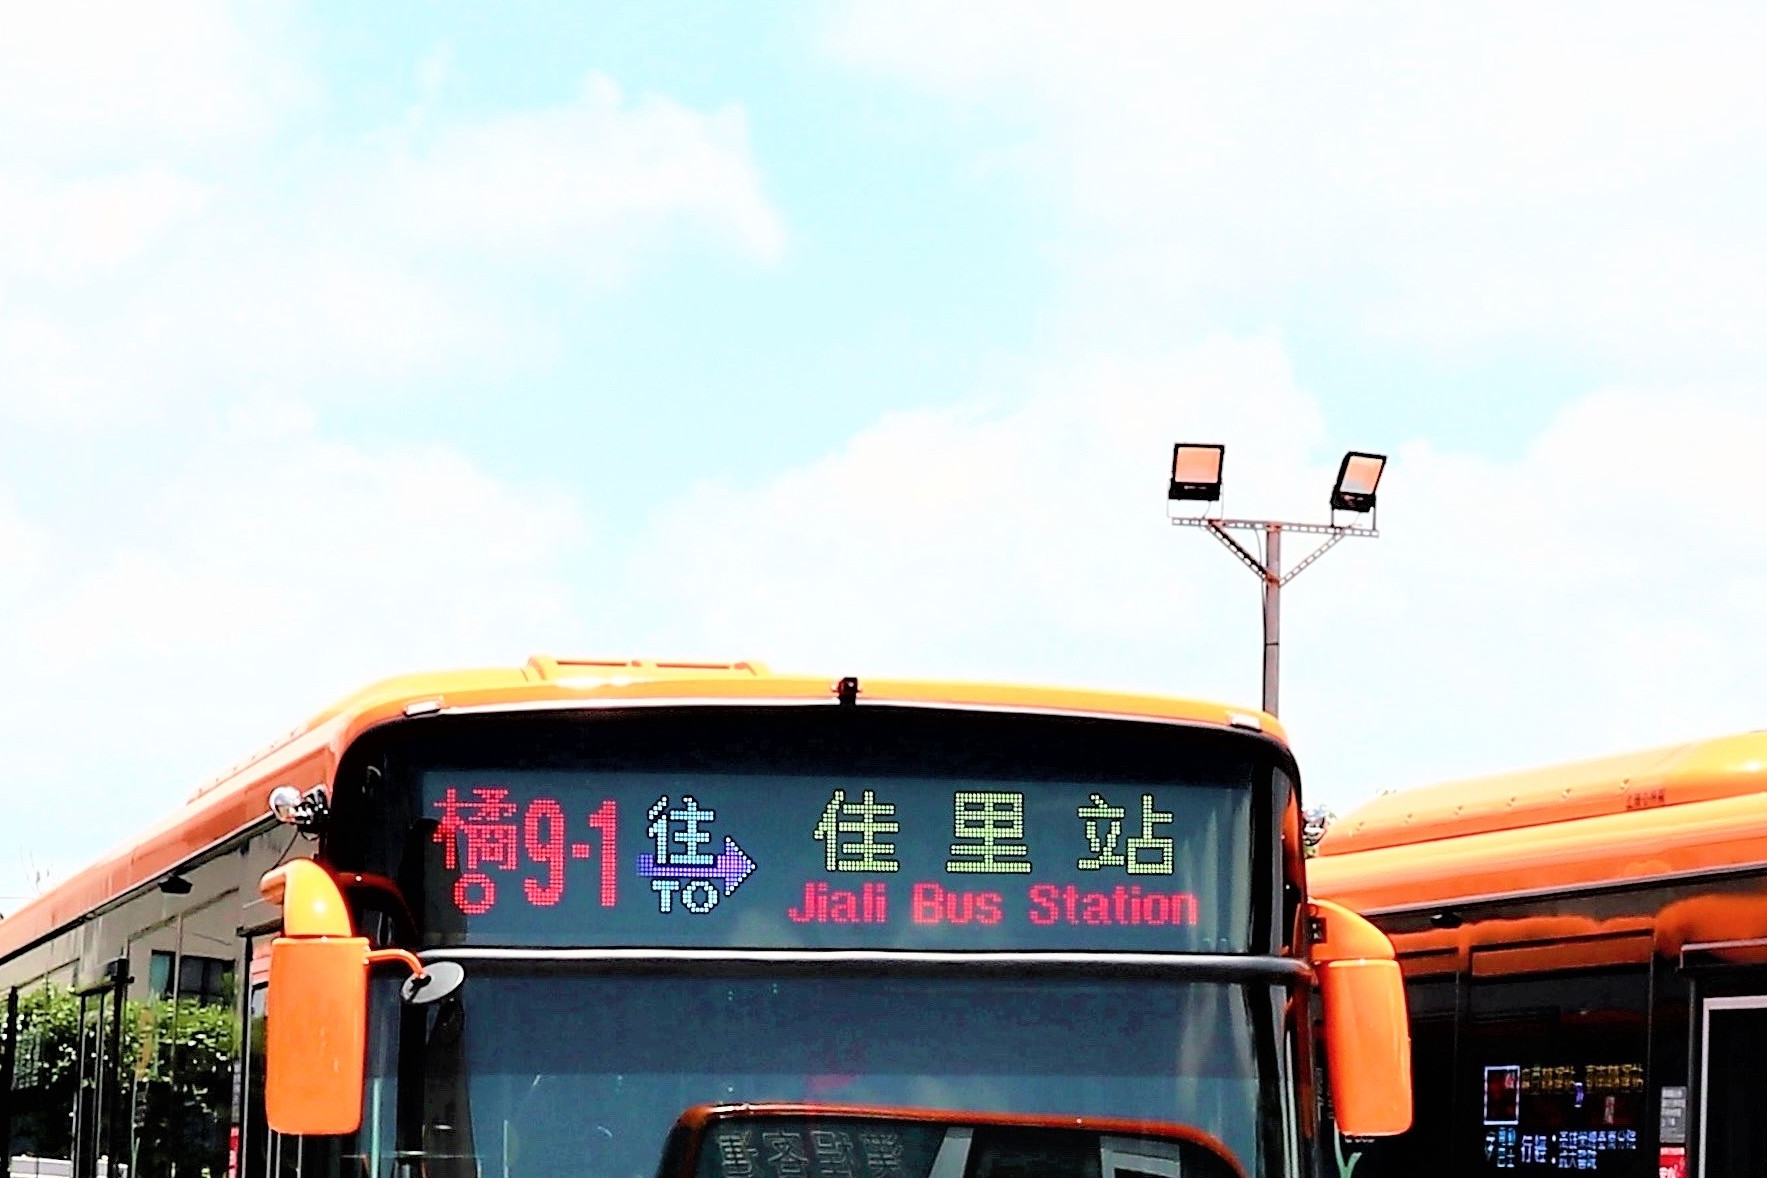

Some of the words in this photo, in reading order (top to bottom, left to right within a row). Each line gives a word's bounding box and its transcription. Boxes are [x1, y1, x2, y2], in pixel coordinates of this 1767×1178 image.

[648, 796, 715, 864] 往
[651, 880, 718, 913] TO
[787, 883, 887, 924] Jiali
[912, 883, 1003, 925] Bus
[1028, 884, 1199, 927] Station
